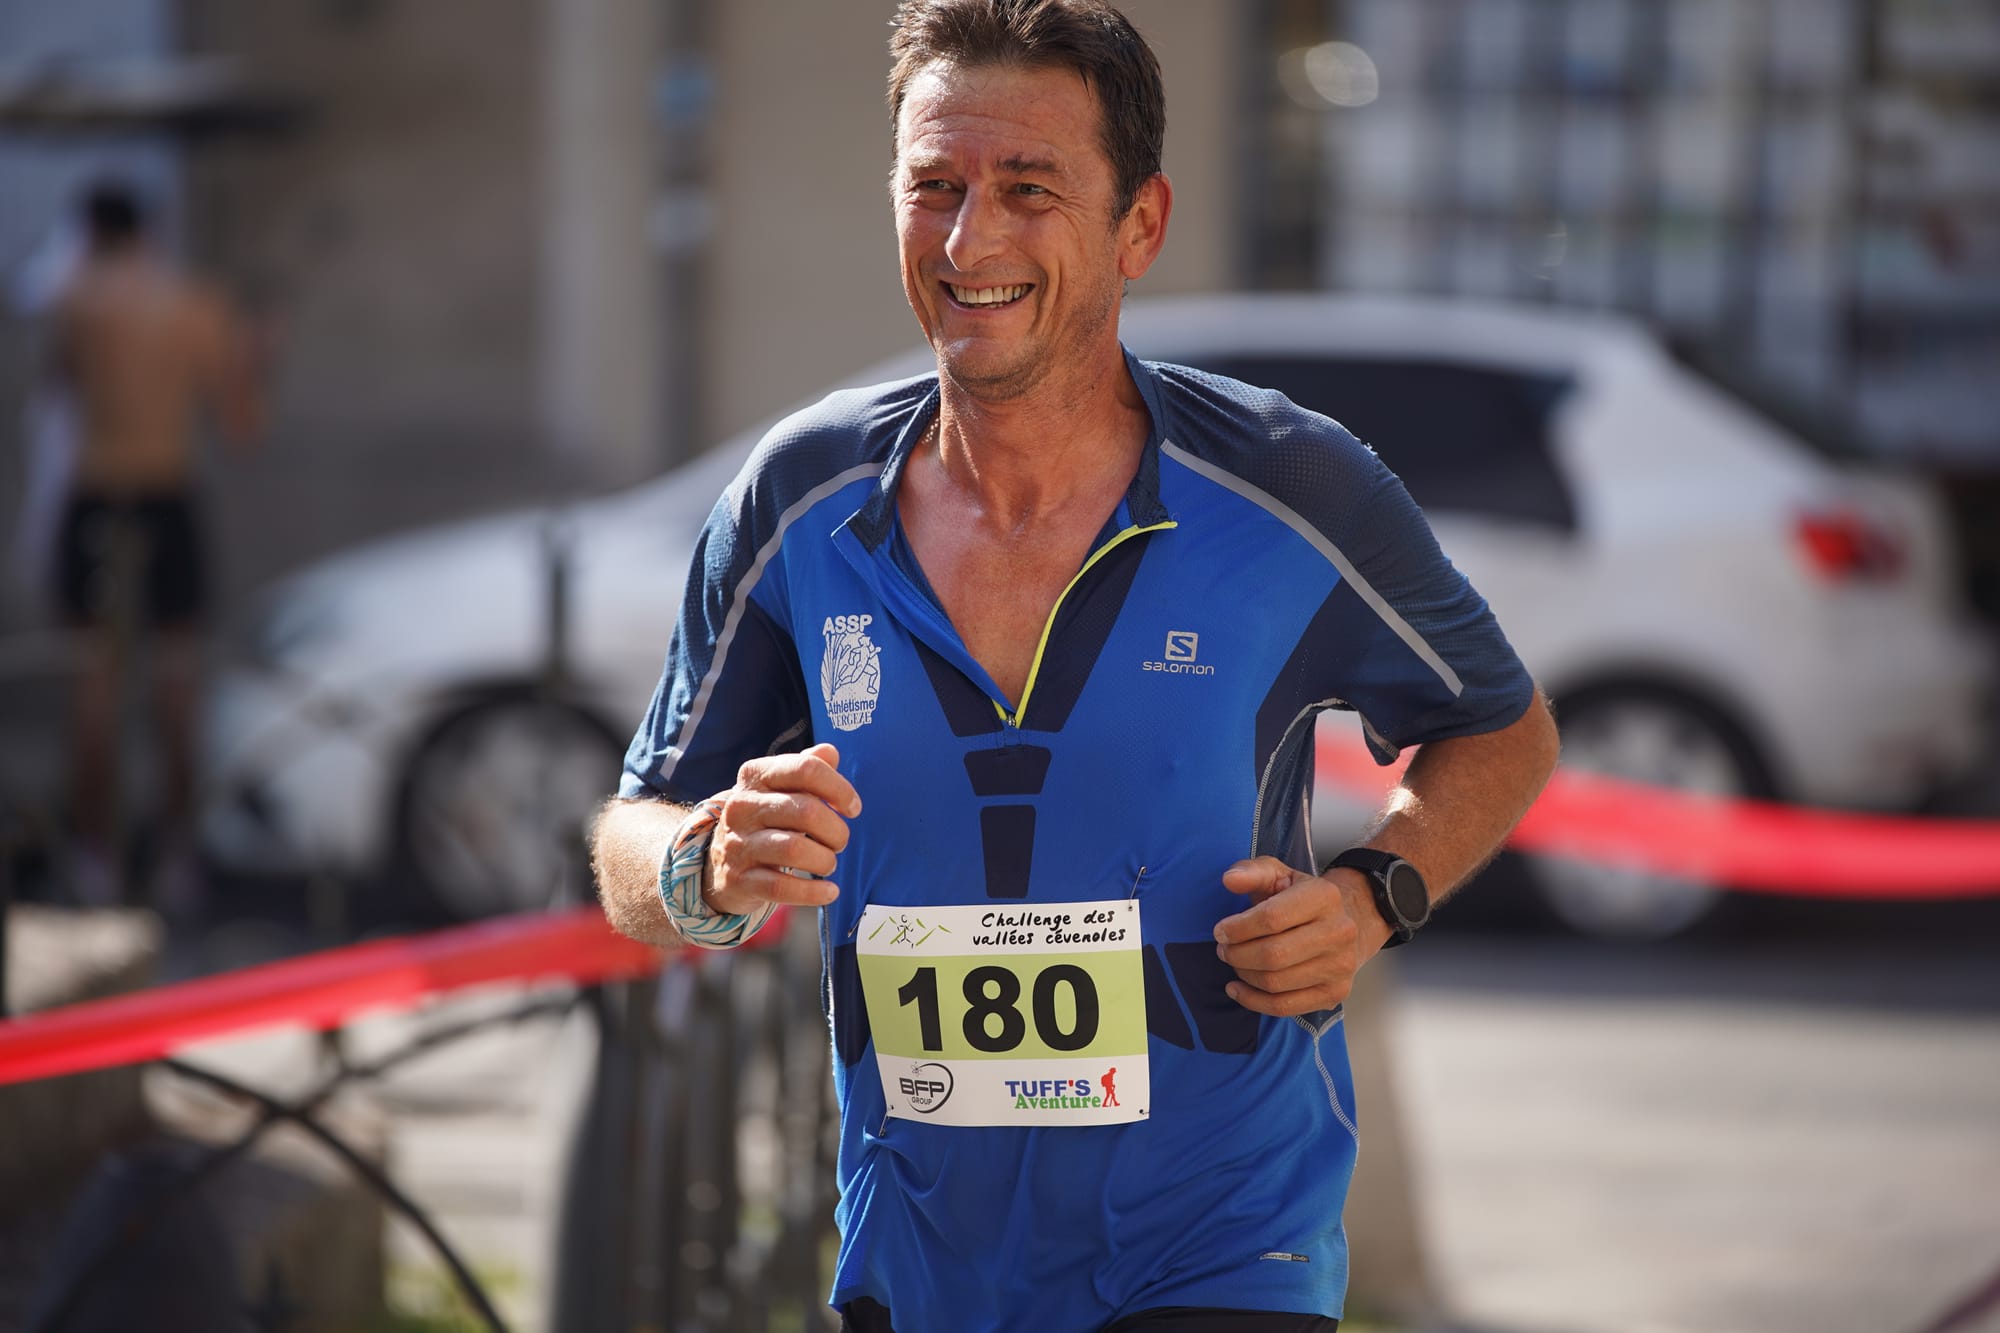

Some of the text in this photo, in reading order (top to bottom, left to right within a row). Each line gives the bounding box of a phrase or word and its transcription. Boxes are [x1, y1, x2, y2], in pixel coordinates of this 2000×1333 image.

[822, 614, 873, 636] ASSP
[981, 910, 1115, 931] Challenge des
[972, 928, 1126, 945] vallées cévenoles
[897, 963, 1099, 1053] 180
[899, 1077, 945, 1098] BFP
[1004, 1079, 1091, 1097] TUFF'S
[911, 1096, 933, 1105] GROUP
[1014, 1093, 1101, 1109] Aventure
